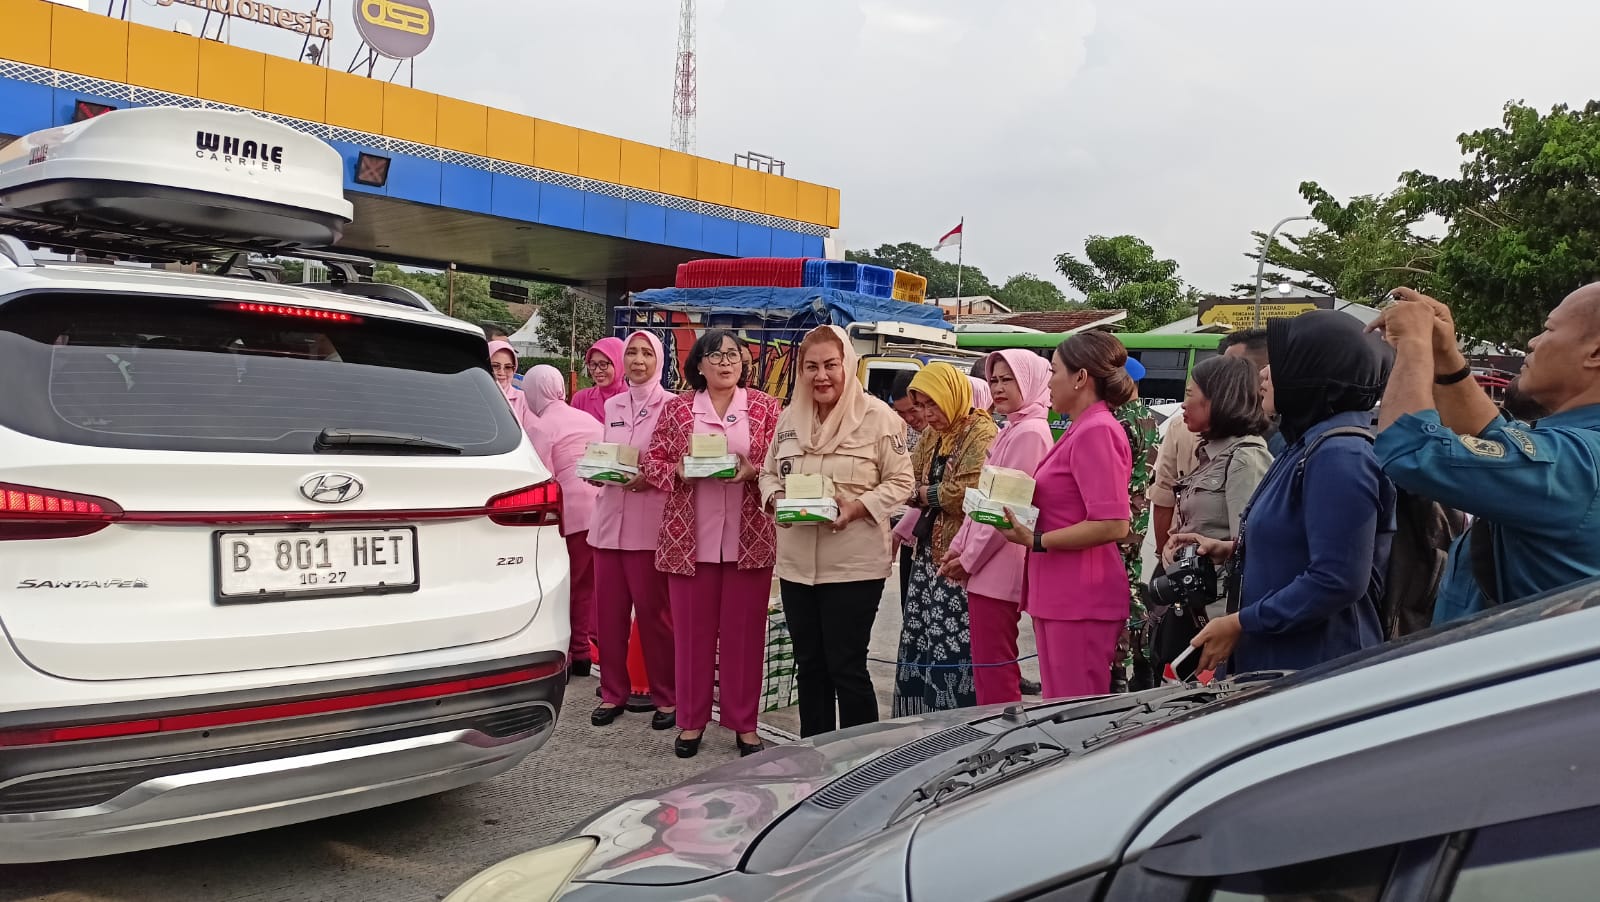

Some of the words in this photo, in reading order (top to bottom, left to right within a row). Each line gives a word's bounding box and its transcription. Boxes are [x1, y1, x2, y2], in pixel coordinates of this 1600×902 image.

[195, 150, 282, 172] CARRIER
[196, 131, 283, 164] WHALE
[232, 540, 252, 572] B
[275, 538, 332, 571] 801
[352, 536, 403, 566] HET
